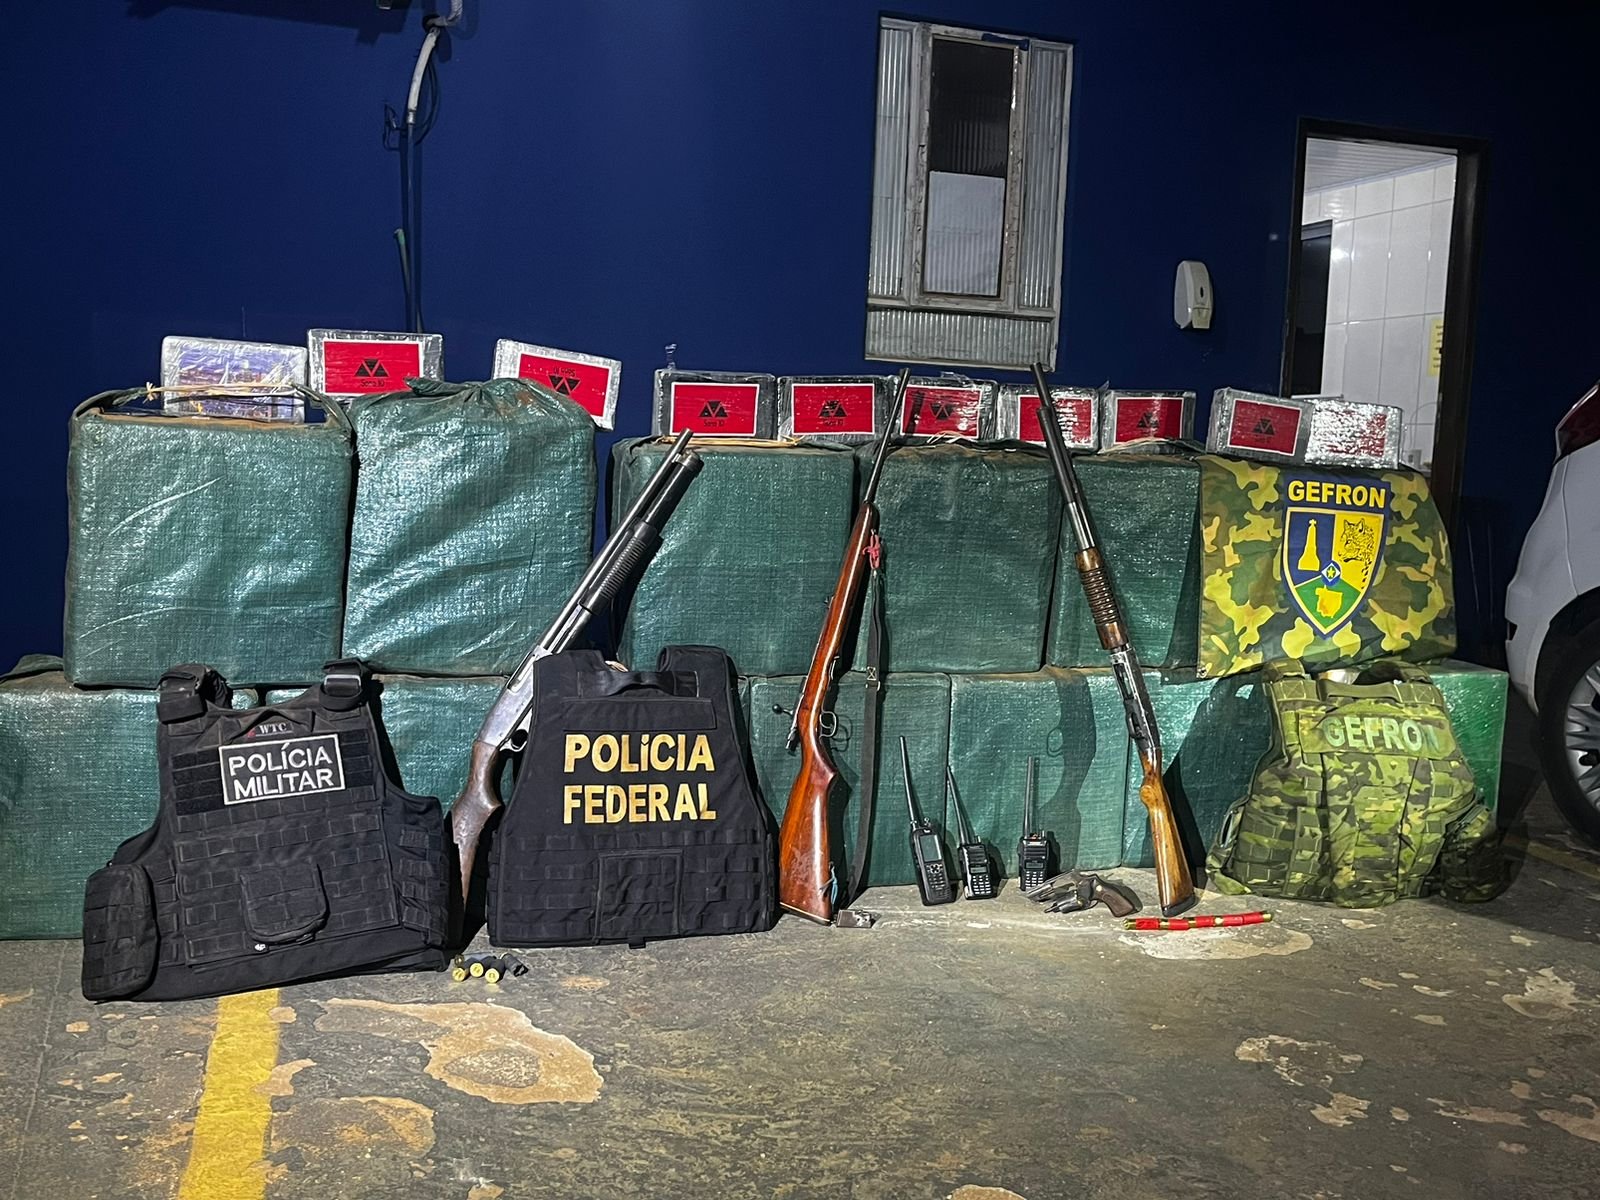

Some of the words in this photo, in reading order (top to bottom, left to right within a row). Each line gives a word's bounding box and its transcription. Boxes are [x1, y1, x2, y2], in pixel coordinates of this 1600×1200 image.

[1287, 480, 1387, 509] GEFRON
[259, 723, 288, 735] WTC
[228, 742, 333, 777] POLÍCIA
[233, 769, 335, 800] MILITAR
[564, 783, 716, 824] FEDERAL
